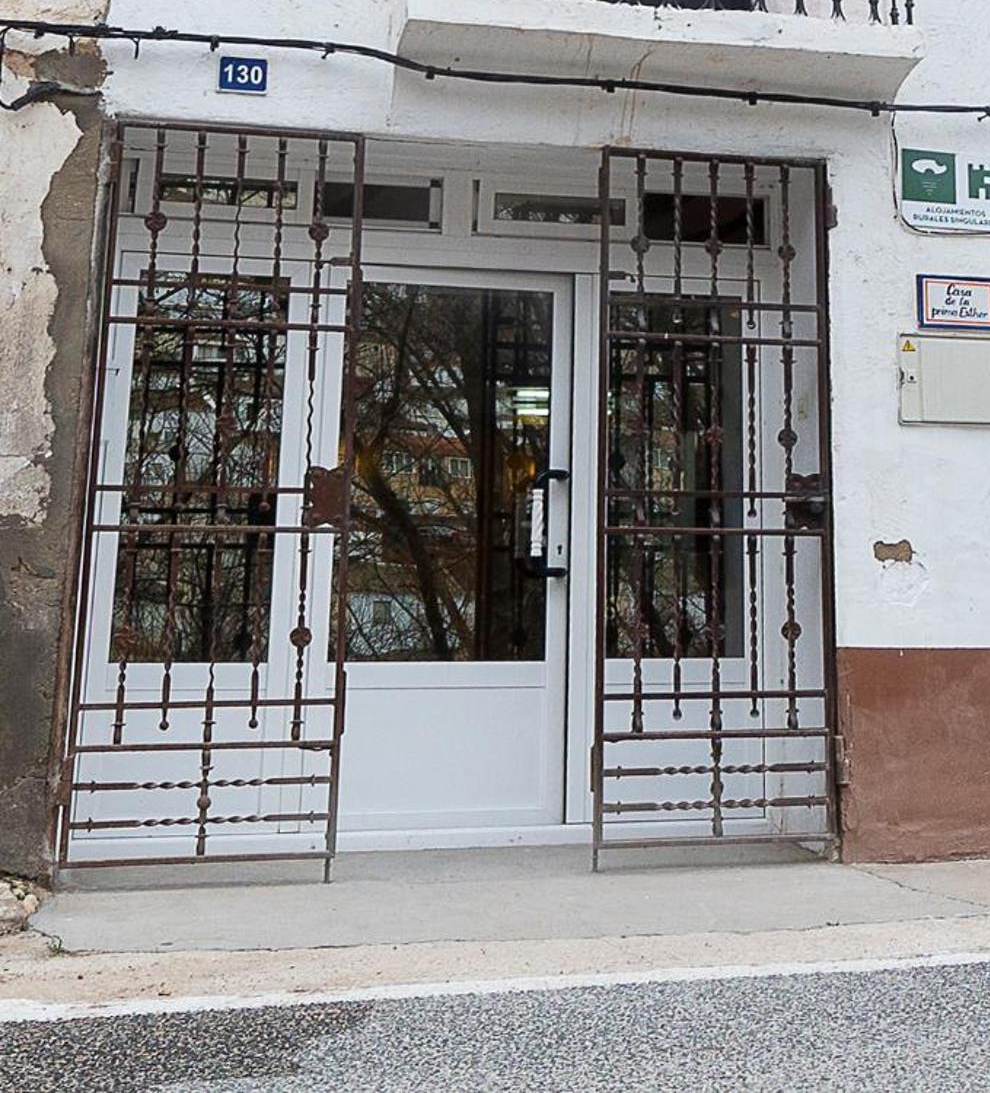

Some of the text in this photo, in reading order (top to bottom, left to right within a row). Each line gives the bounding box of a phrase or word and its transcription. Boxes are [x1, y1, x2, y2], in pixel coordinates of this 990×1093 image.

[224, 64, 263, 84] 130
[926, 206, 986, 217] ALOJAMIENTOS
[913, 213, 949, 223] RURALES
[946, 283, 973, 296] Casa
[945, 297, 970, 306] de la
[931, 307, 958, 318] prima
